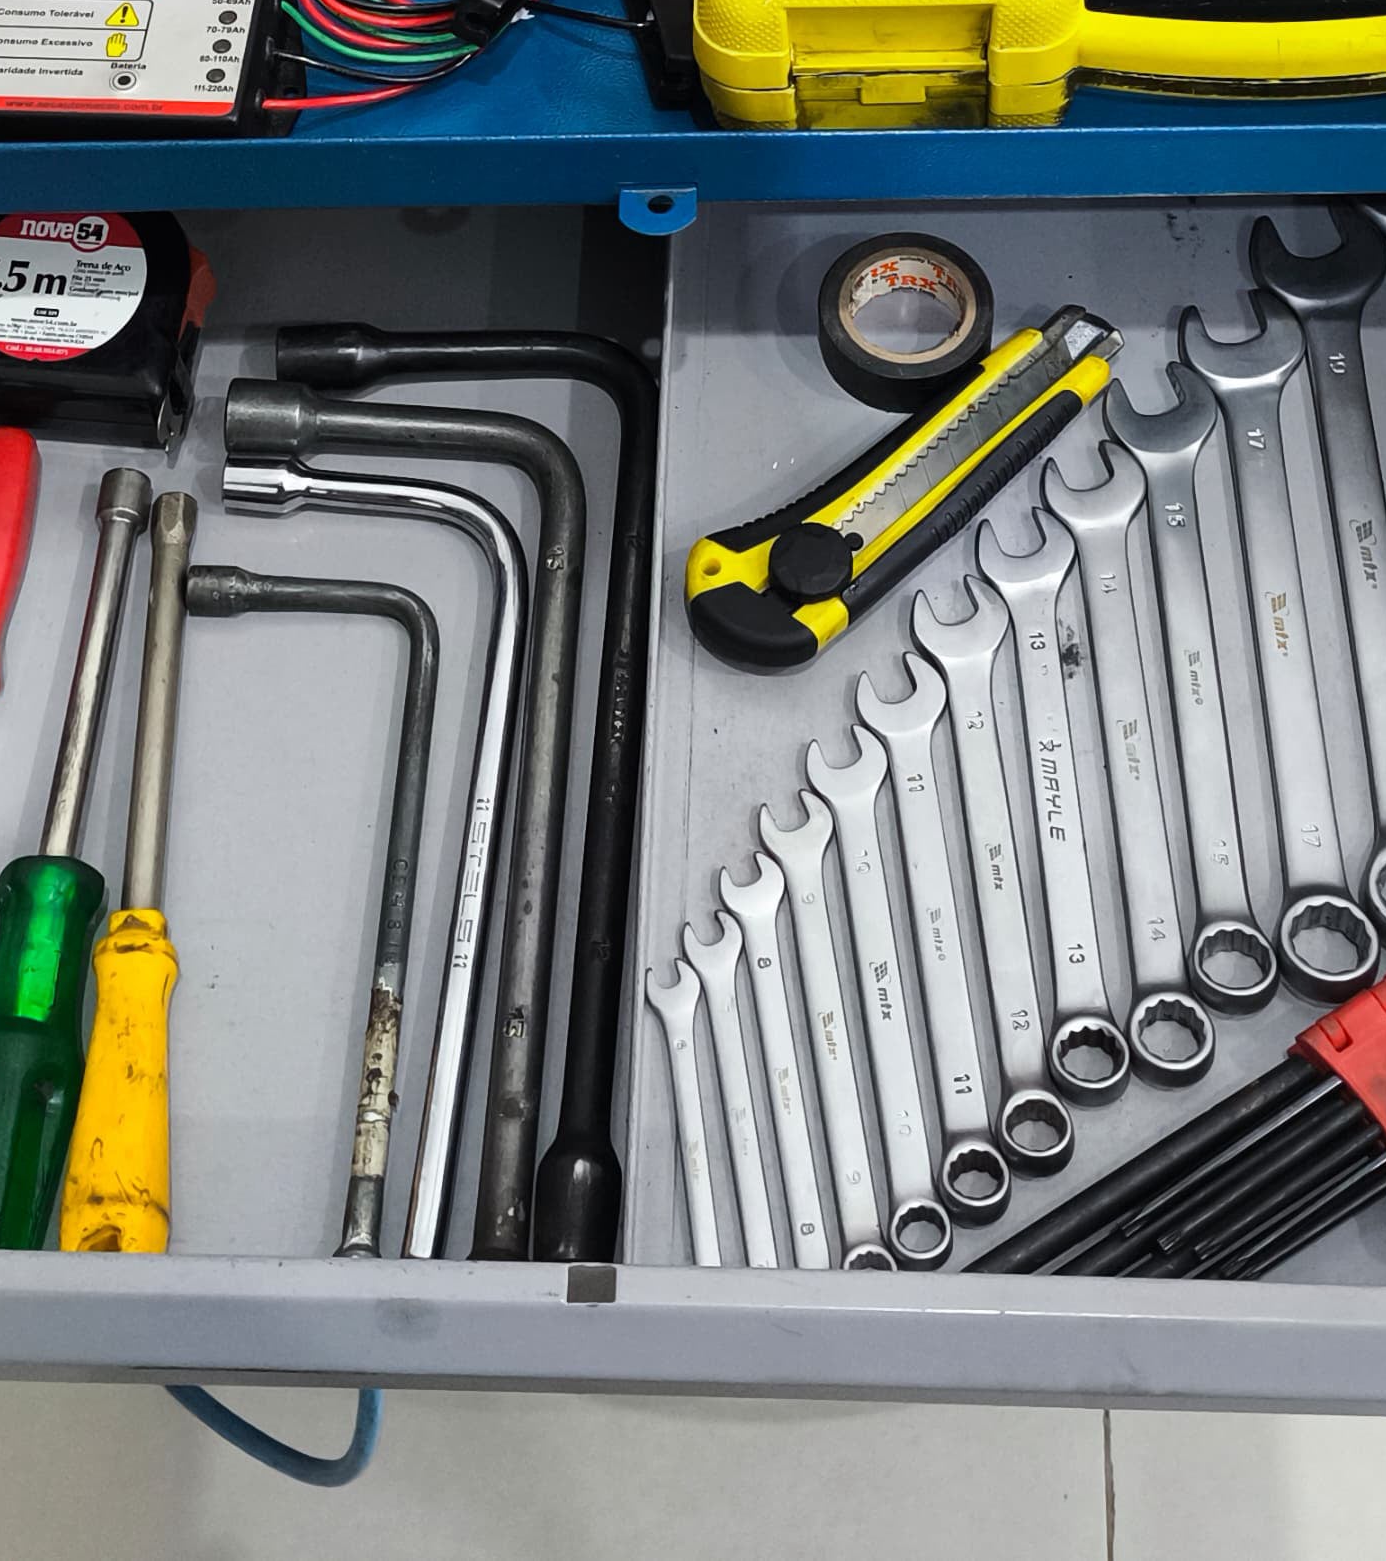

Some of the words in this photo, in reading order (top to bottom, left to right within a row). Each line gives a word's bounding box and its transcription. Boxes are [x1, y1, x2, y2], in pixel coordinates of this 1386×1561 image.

[50, 8, 95, 19] Tolerável
[41, 37, 94, 48] Excessivo
[37, 66, 83, 77] Invertida
[110, 61, 147, 70] Bateria
[76, 260, 99, 270] Trena
[101, 262, 112, 271] de
[113, 262, 132, 274] Aço
[33, 272, 67, 296] m
[1028, 631, 1046, 651] 13
[1068, 943, 1085, 965] 13
